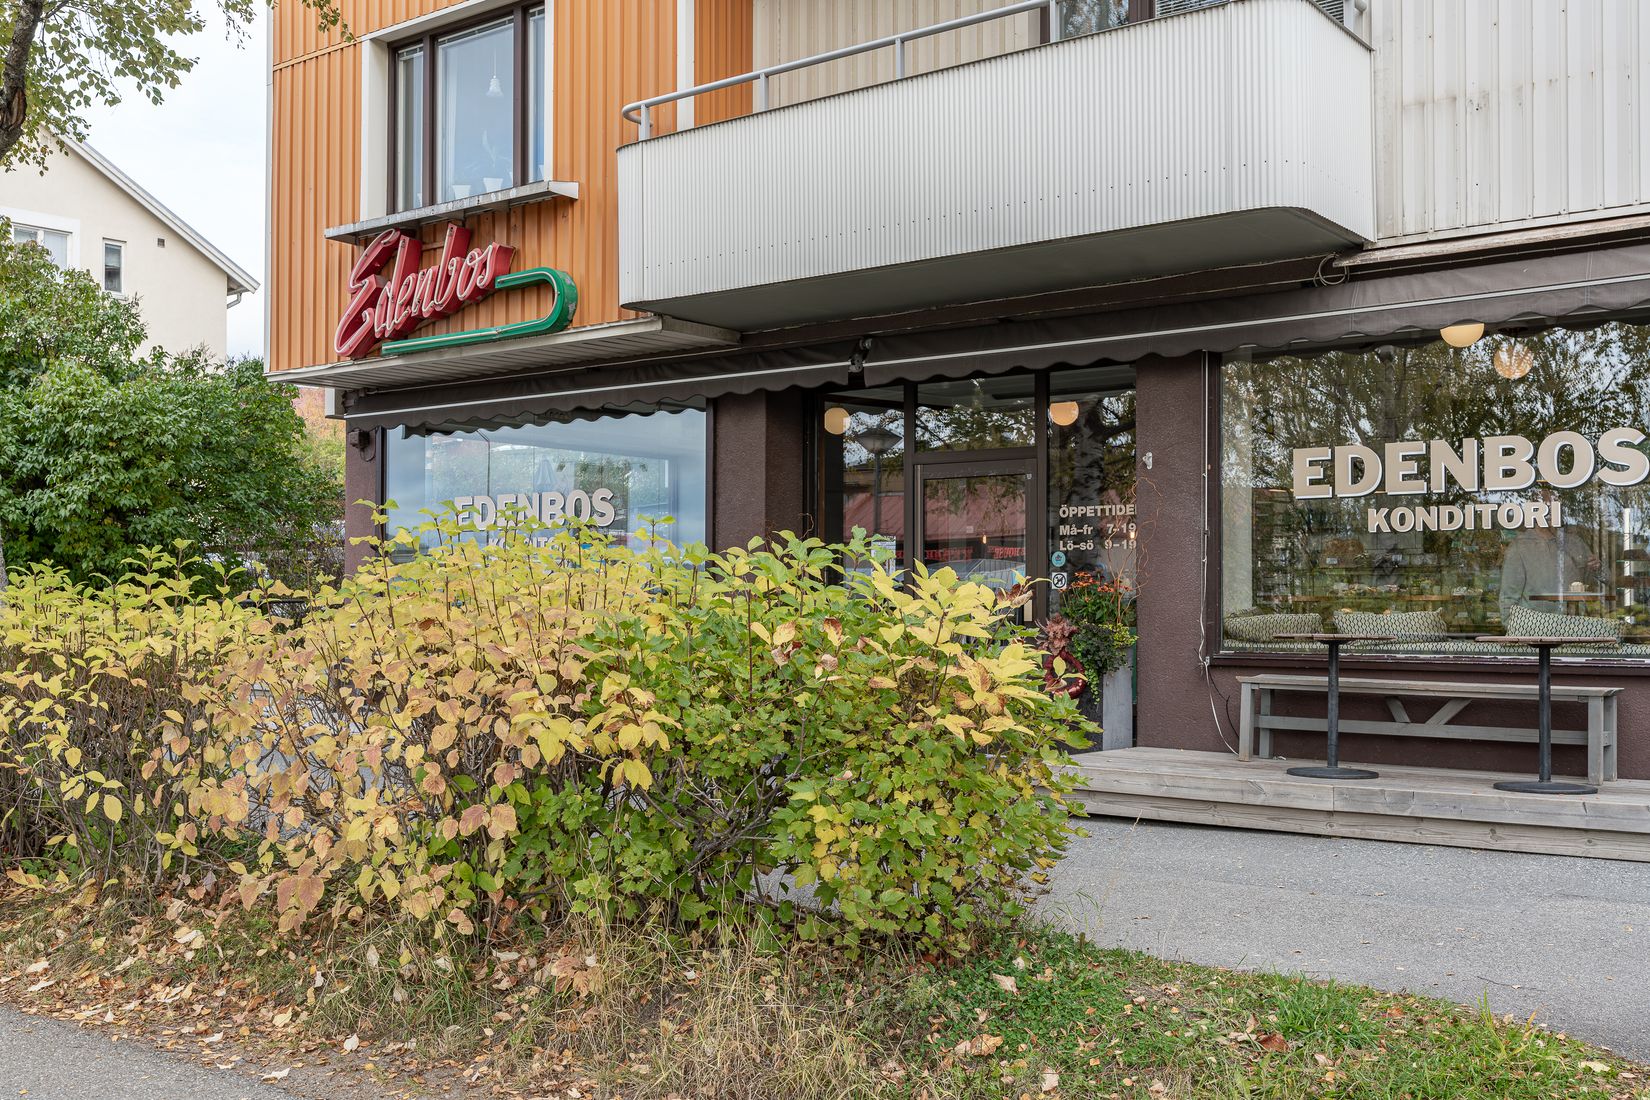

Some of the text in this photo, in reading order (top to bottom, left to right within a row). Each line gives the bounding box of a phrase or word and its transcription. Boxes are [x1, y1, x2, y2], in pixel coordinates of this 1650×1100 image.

[334, 223, 511, 358] Edenbos
[1293, 427, 1650, 499] EDENBOS
[454, 487, 615, 531] EDENBOS
[1059, 504, 1137, 518] ÖPPETTIDE
[1367, 500, 1563, 533] KONDITORI
